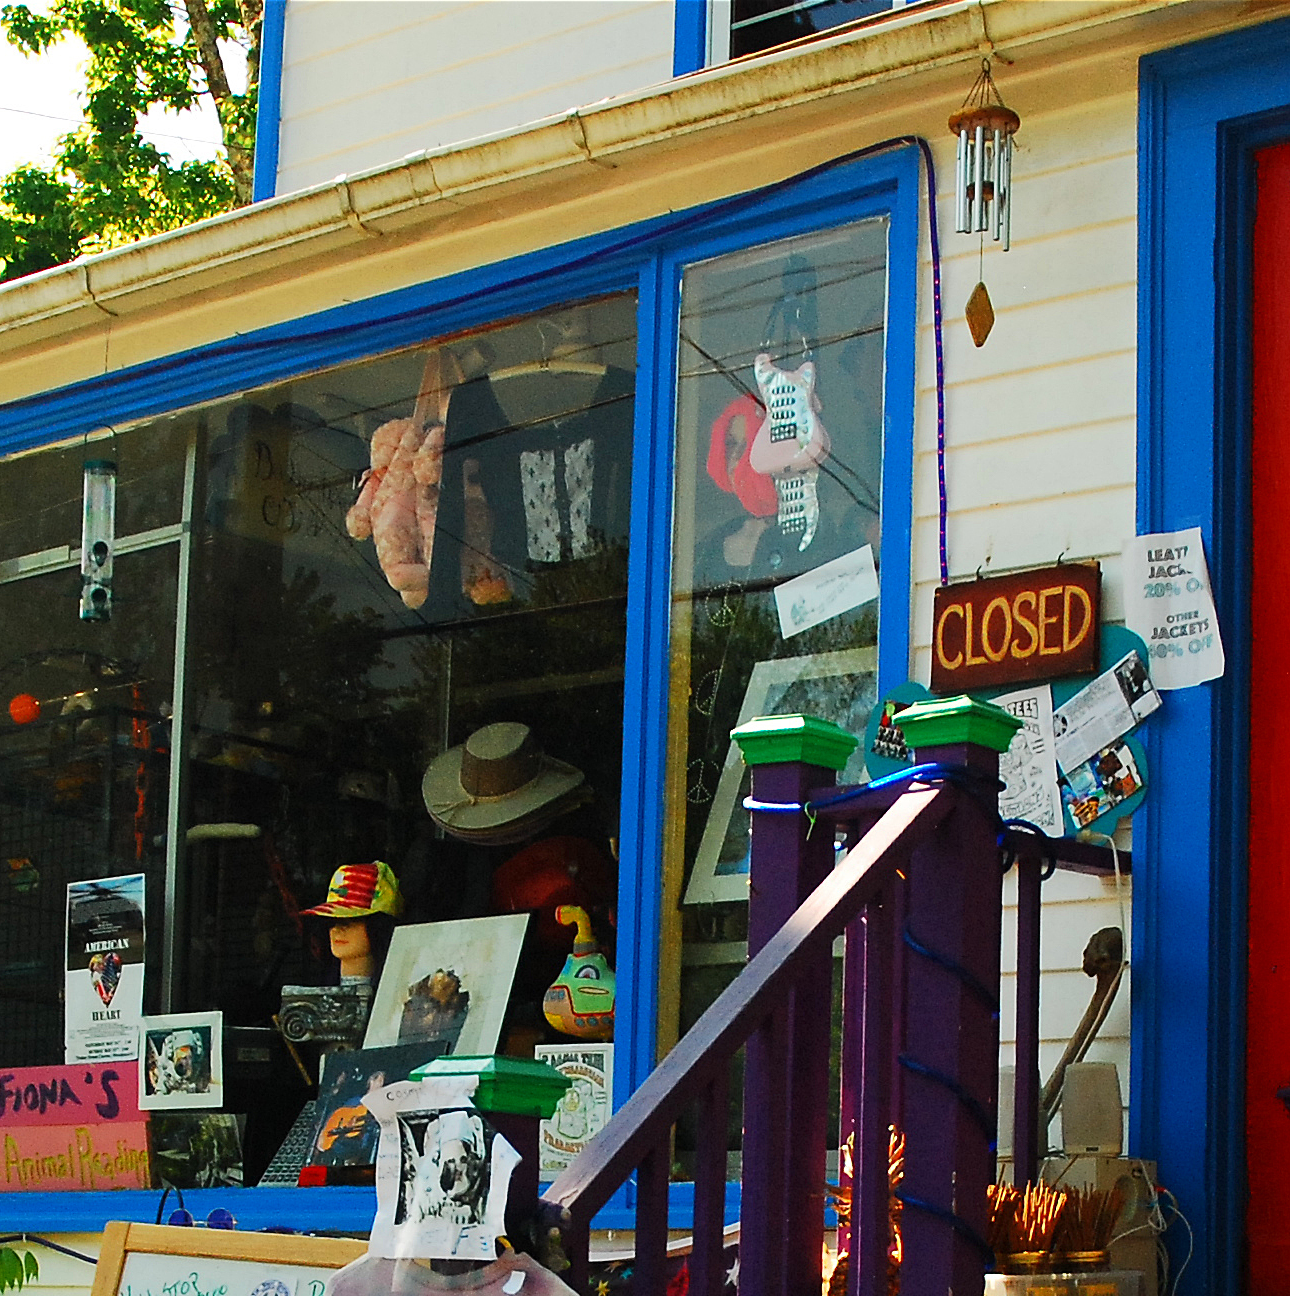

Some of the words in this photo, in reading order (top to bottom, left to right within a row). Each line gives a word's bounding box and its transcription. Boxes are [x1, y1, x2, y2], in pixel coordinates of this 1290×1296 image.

[1143, 582, 1182, 598] 20%
[1166, 610, 1199, 624] OTHER
[935, 584, 1093, 671] CLOSED
[1151, 618, 1209, 640] JACKETS
[84, 937, 130, 953] AMERICAN
[92, 1009, 121, 1021] HEART
[4, 1133, 76, 1188] Animal
